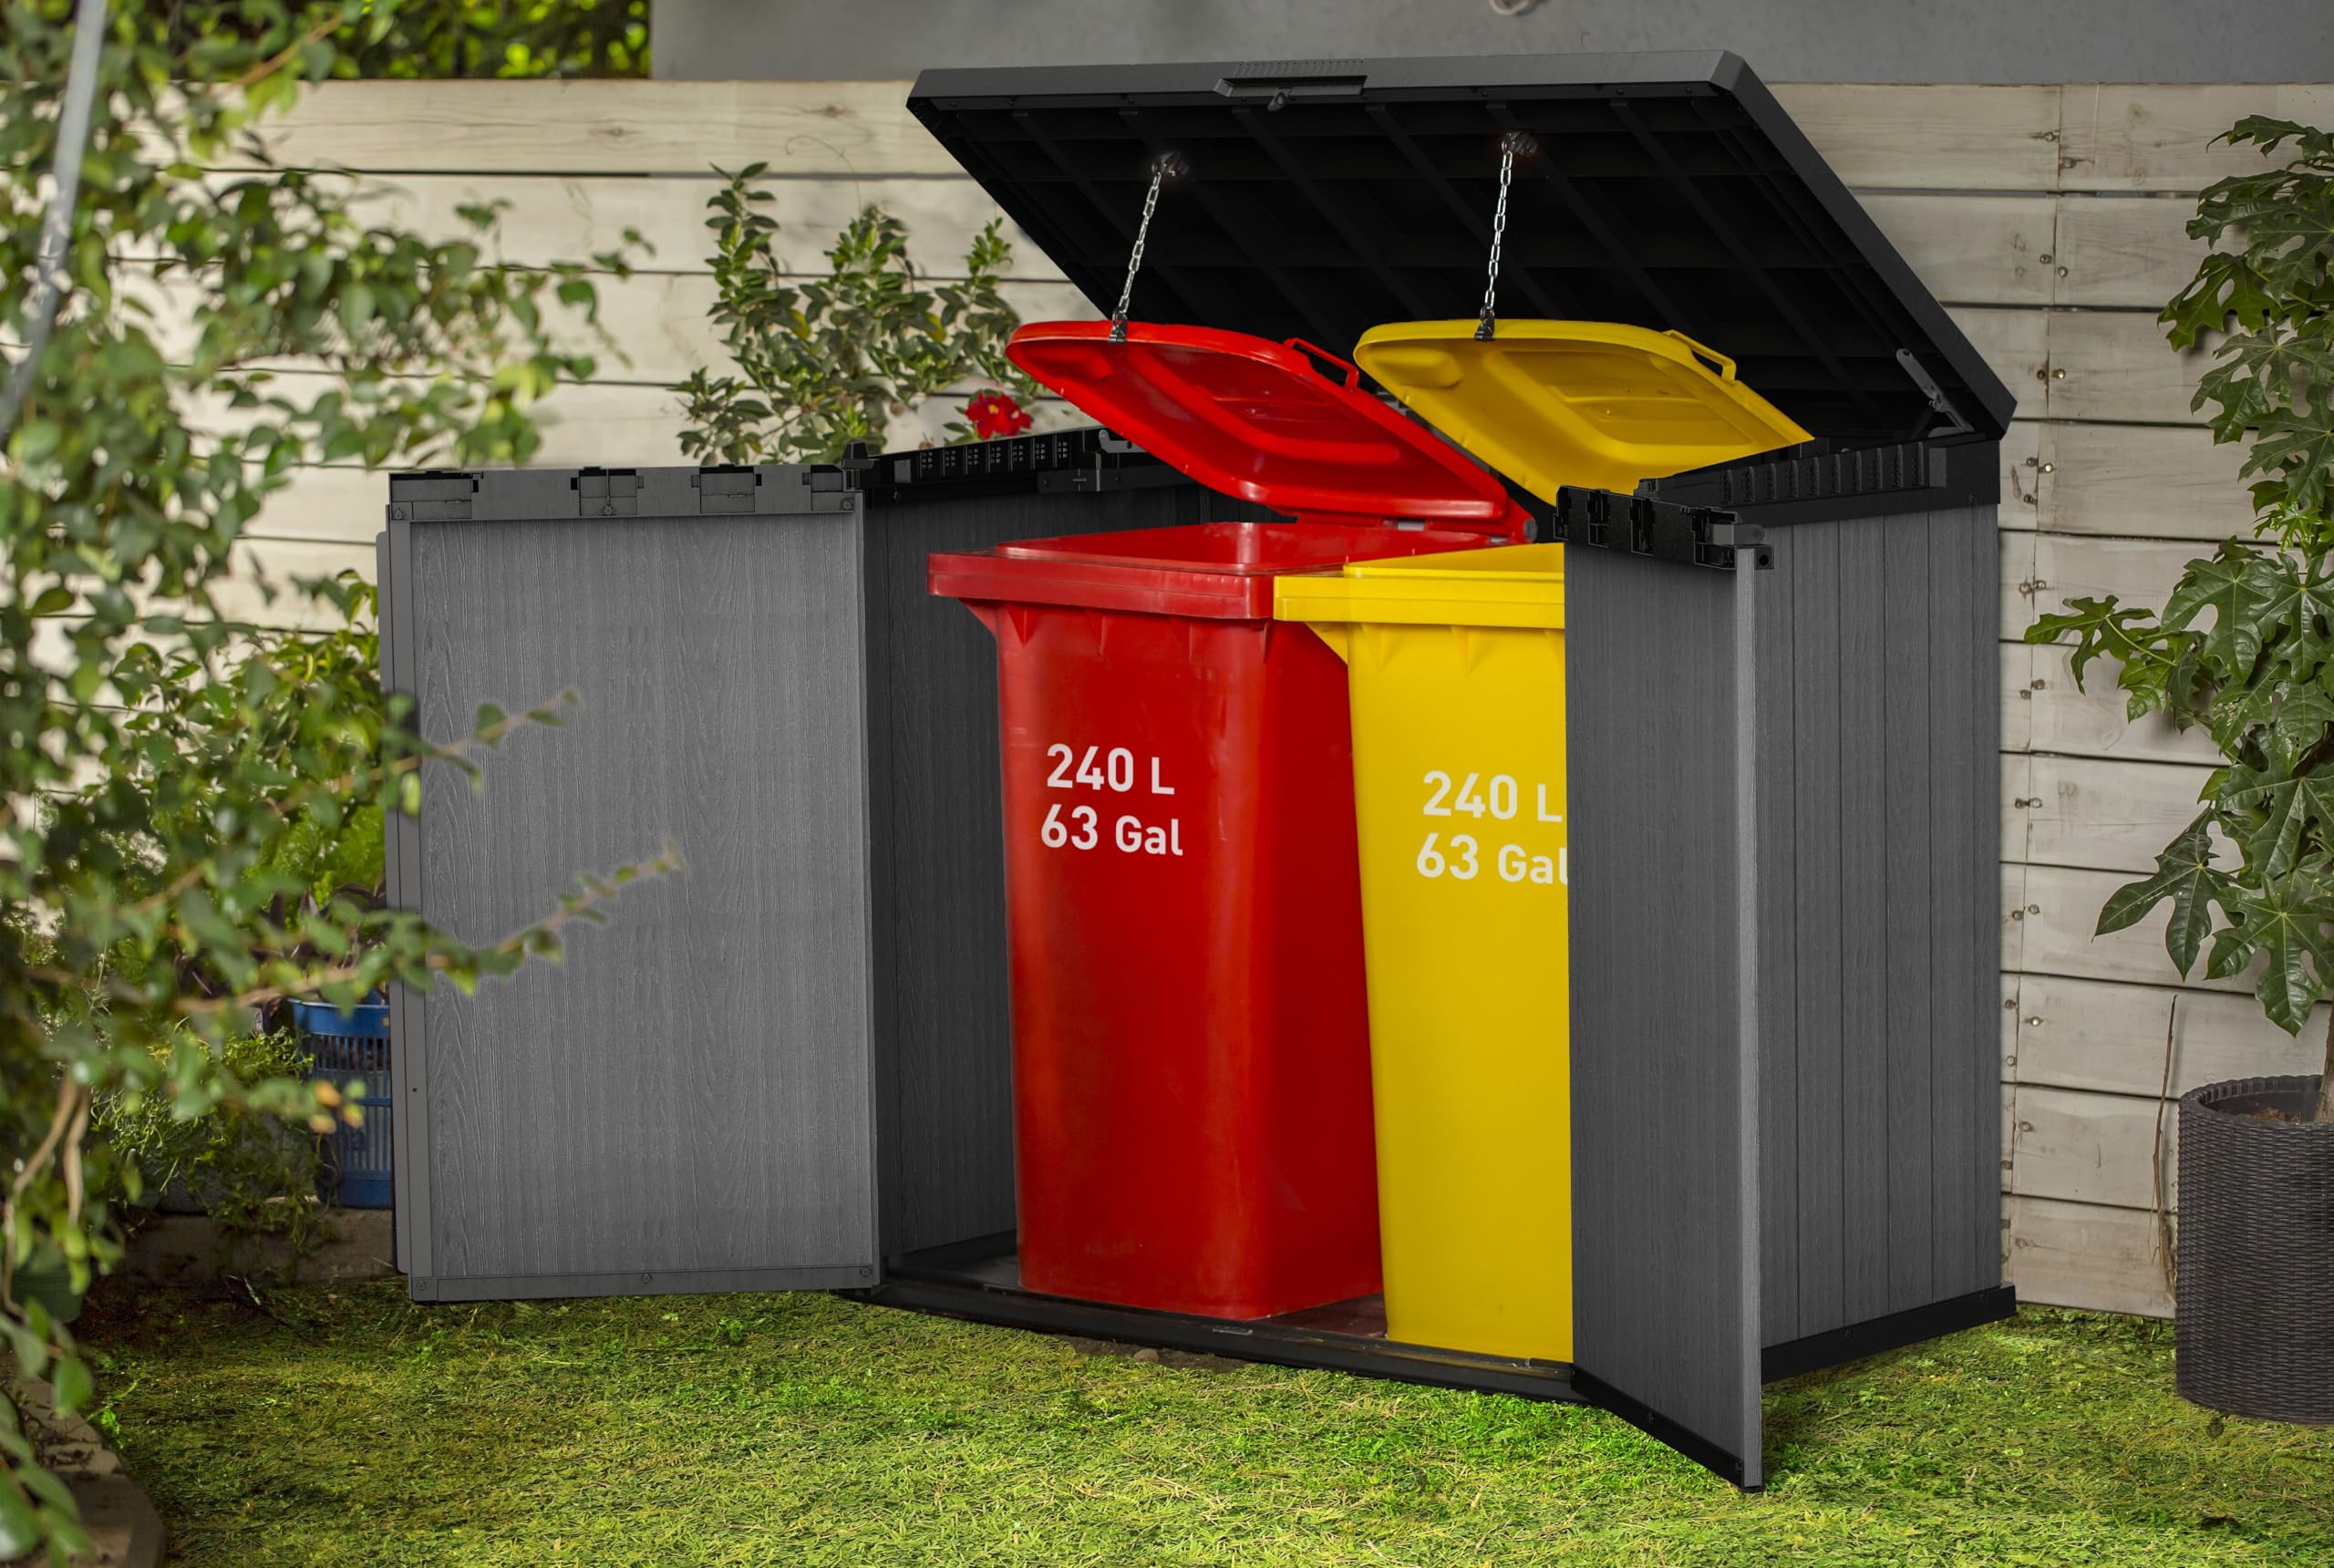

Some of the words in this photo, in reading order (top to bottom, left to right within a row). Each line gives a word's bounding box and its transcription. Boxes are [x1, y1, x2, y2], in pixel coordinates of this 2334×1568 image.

[1047, 743, 1134, 792] 240
[1151, 756, 1176, 795] L
[1422, 769, 1518, 820] 240
[1537, 783, 1563, 823] L
[1040, 803, 1099, 851] 63
[1115, 816, 1183, 856] Gal
[1416, 832, 1479, 880] 63
[1497, 843, 1568, 886] Gal
